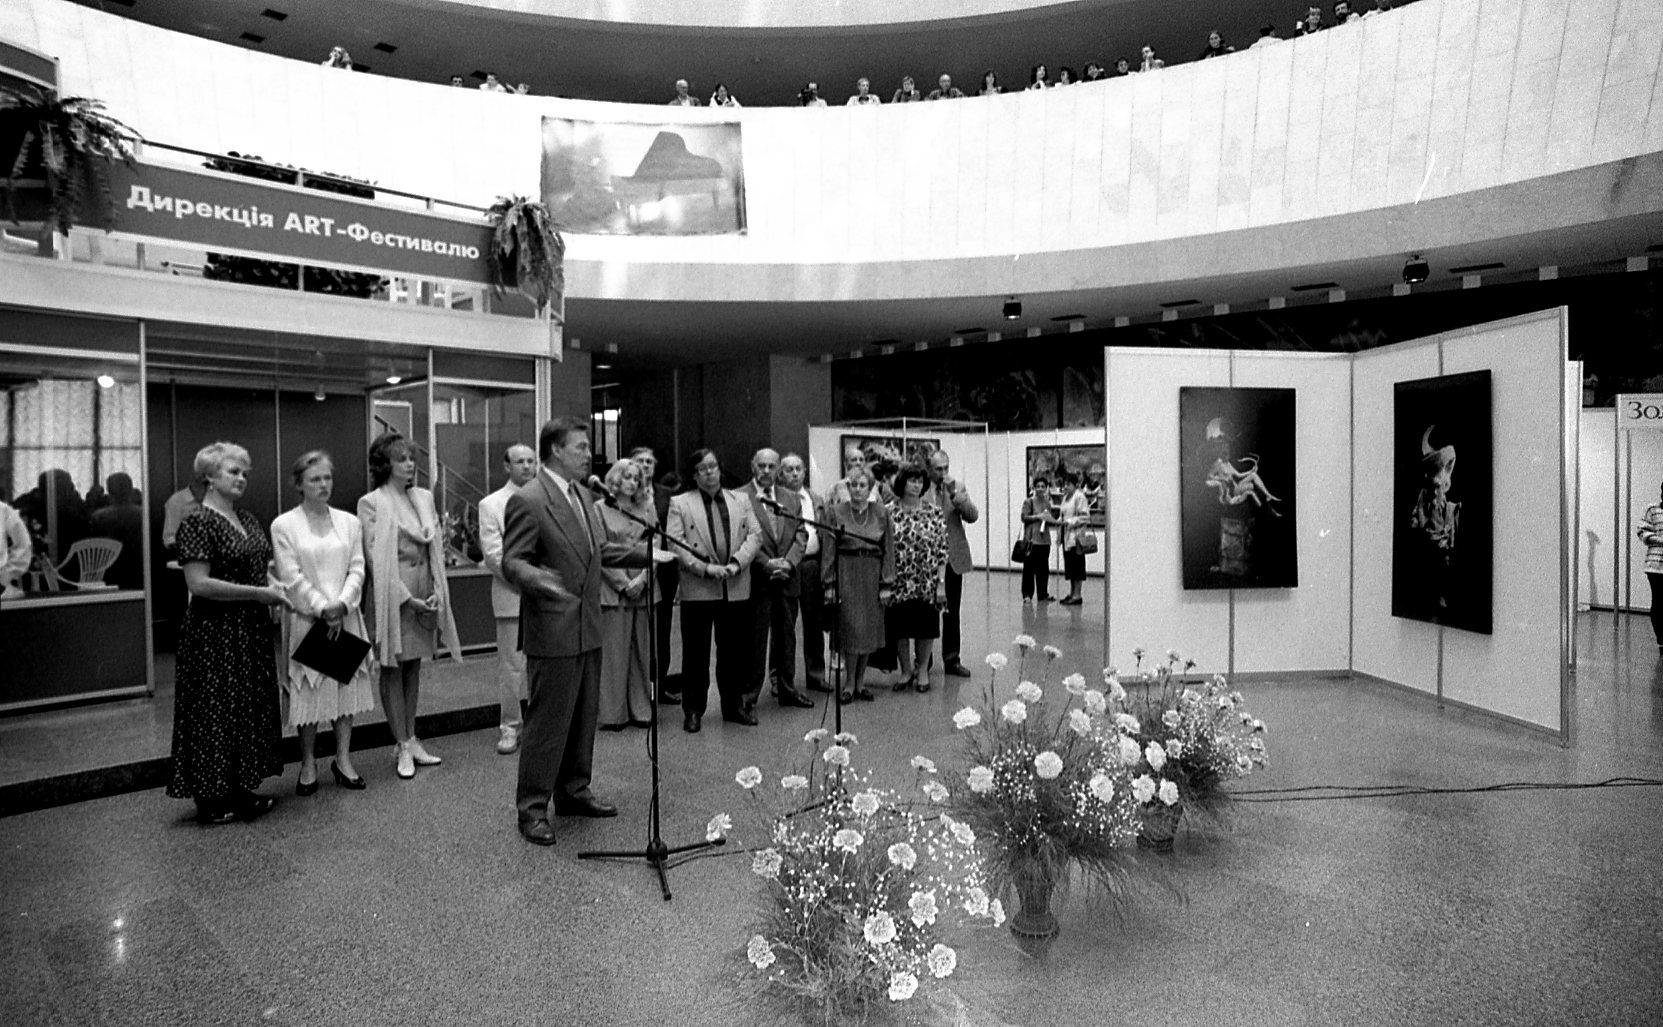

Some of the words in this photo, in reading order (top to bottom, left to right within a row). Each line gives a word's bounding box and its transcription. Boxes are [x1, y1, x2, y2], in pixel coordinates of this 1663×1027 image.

[126, 184, 274, 228] Дирекція
[283, 211, 480, 260] ART-Фестивалю
[1628, 401, 1663, 420] Зо
